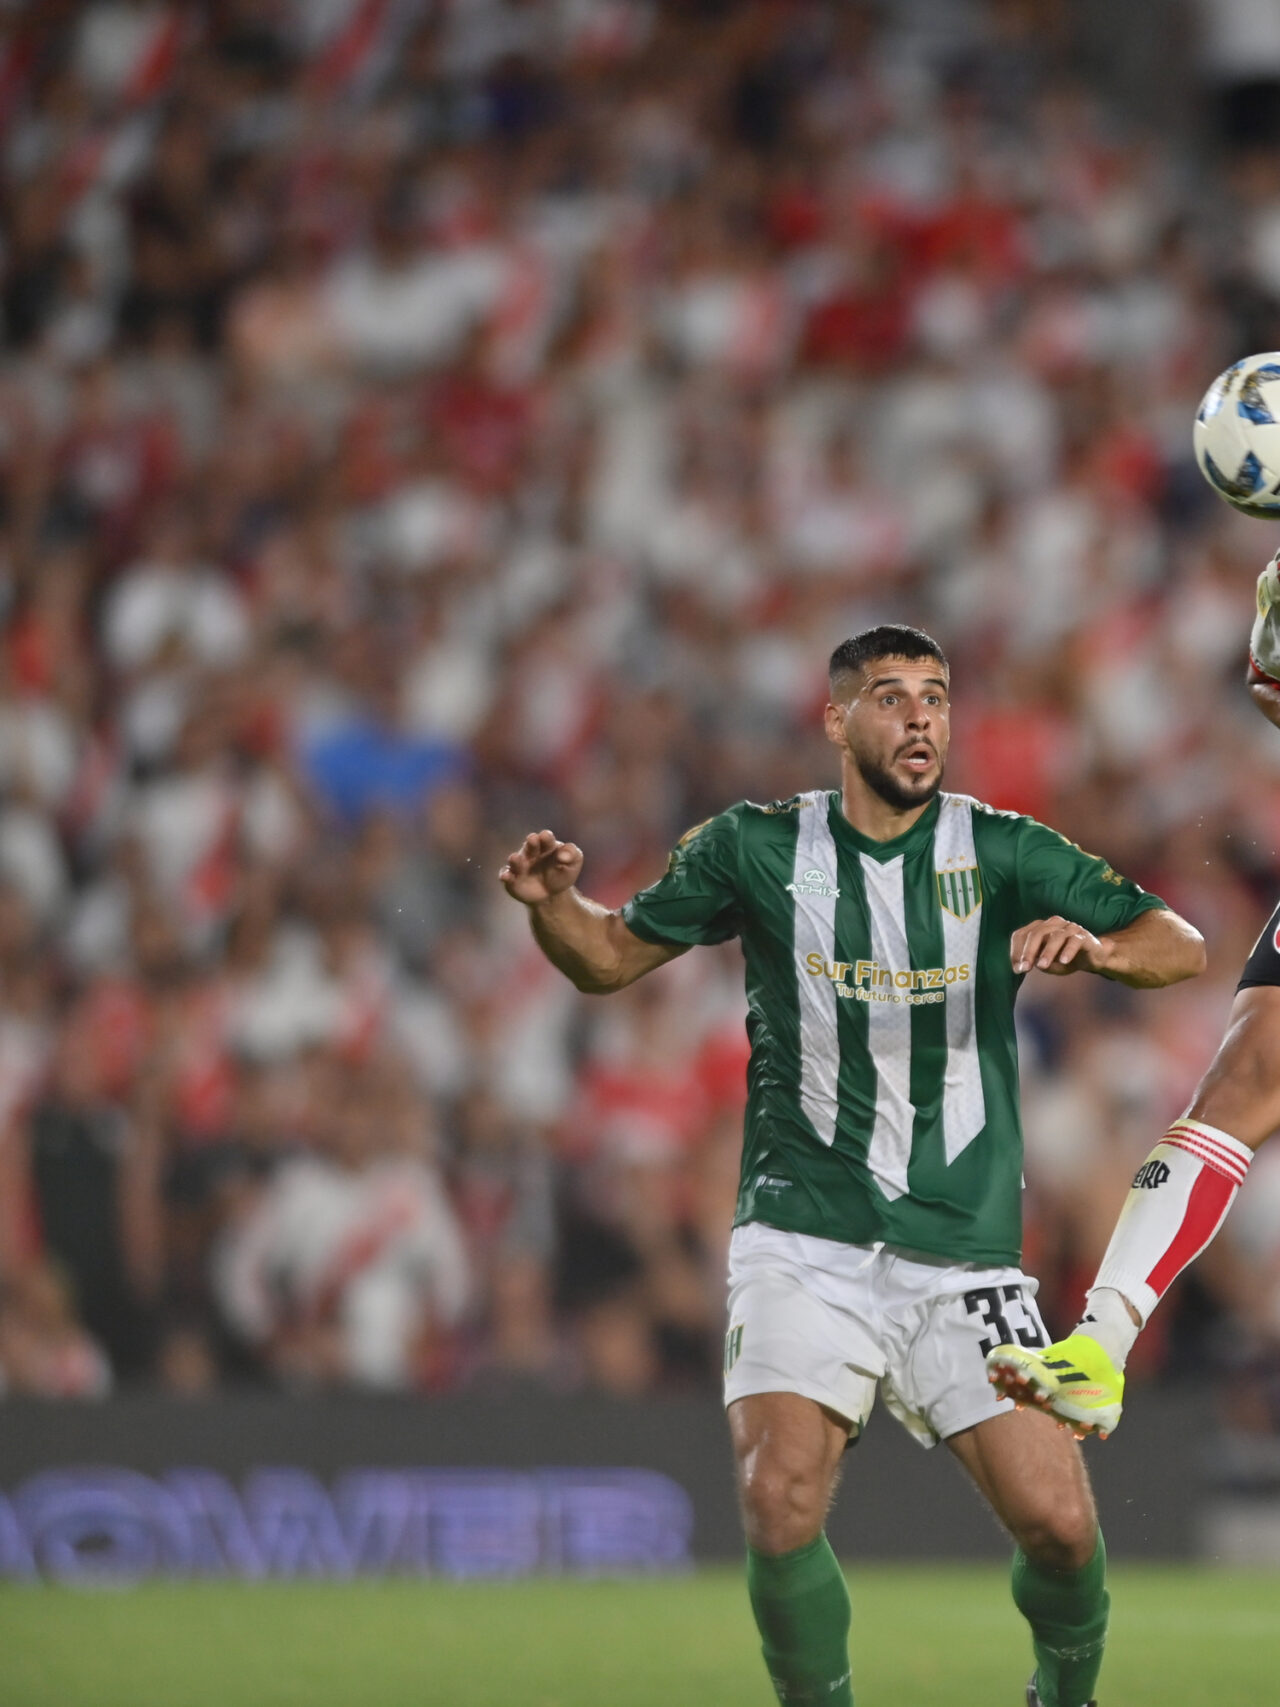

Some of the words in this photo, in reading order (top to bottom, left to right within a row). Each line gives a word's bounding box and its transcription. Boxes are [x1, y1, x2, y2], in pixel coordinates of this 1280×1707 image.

[785, 883, 841, 898] ATHIX
[805, 952, 852, 982] Sur
[855, 959, 970, 989] Finanzas
[836, 984, 854, 998] Tu
[856, 986, 901, 1003] futuro
[905, 991, 945, 1005] cerca
[963, 1283, 1046, 1360] 33
